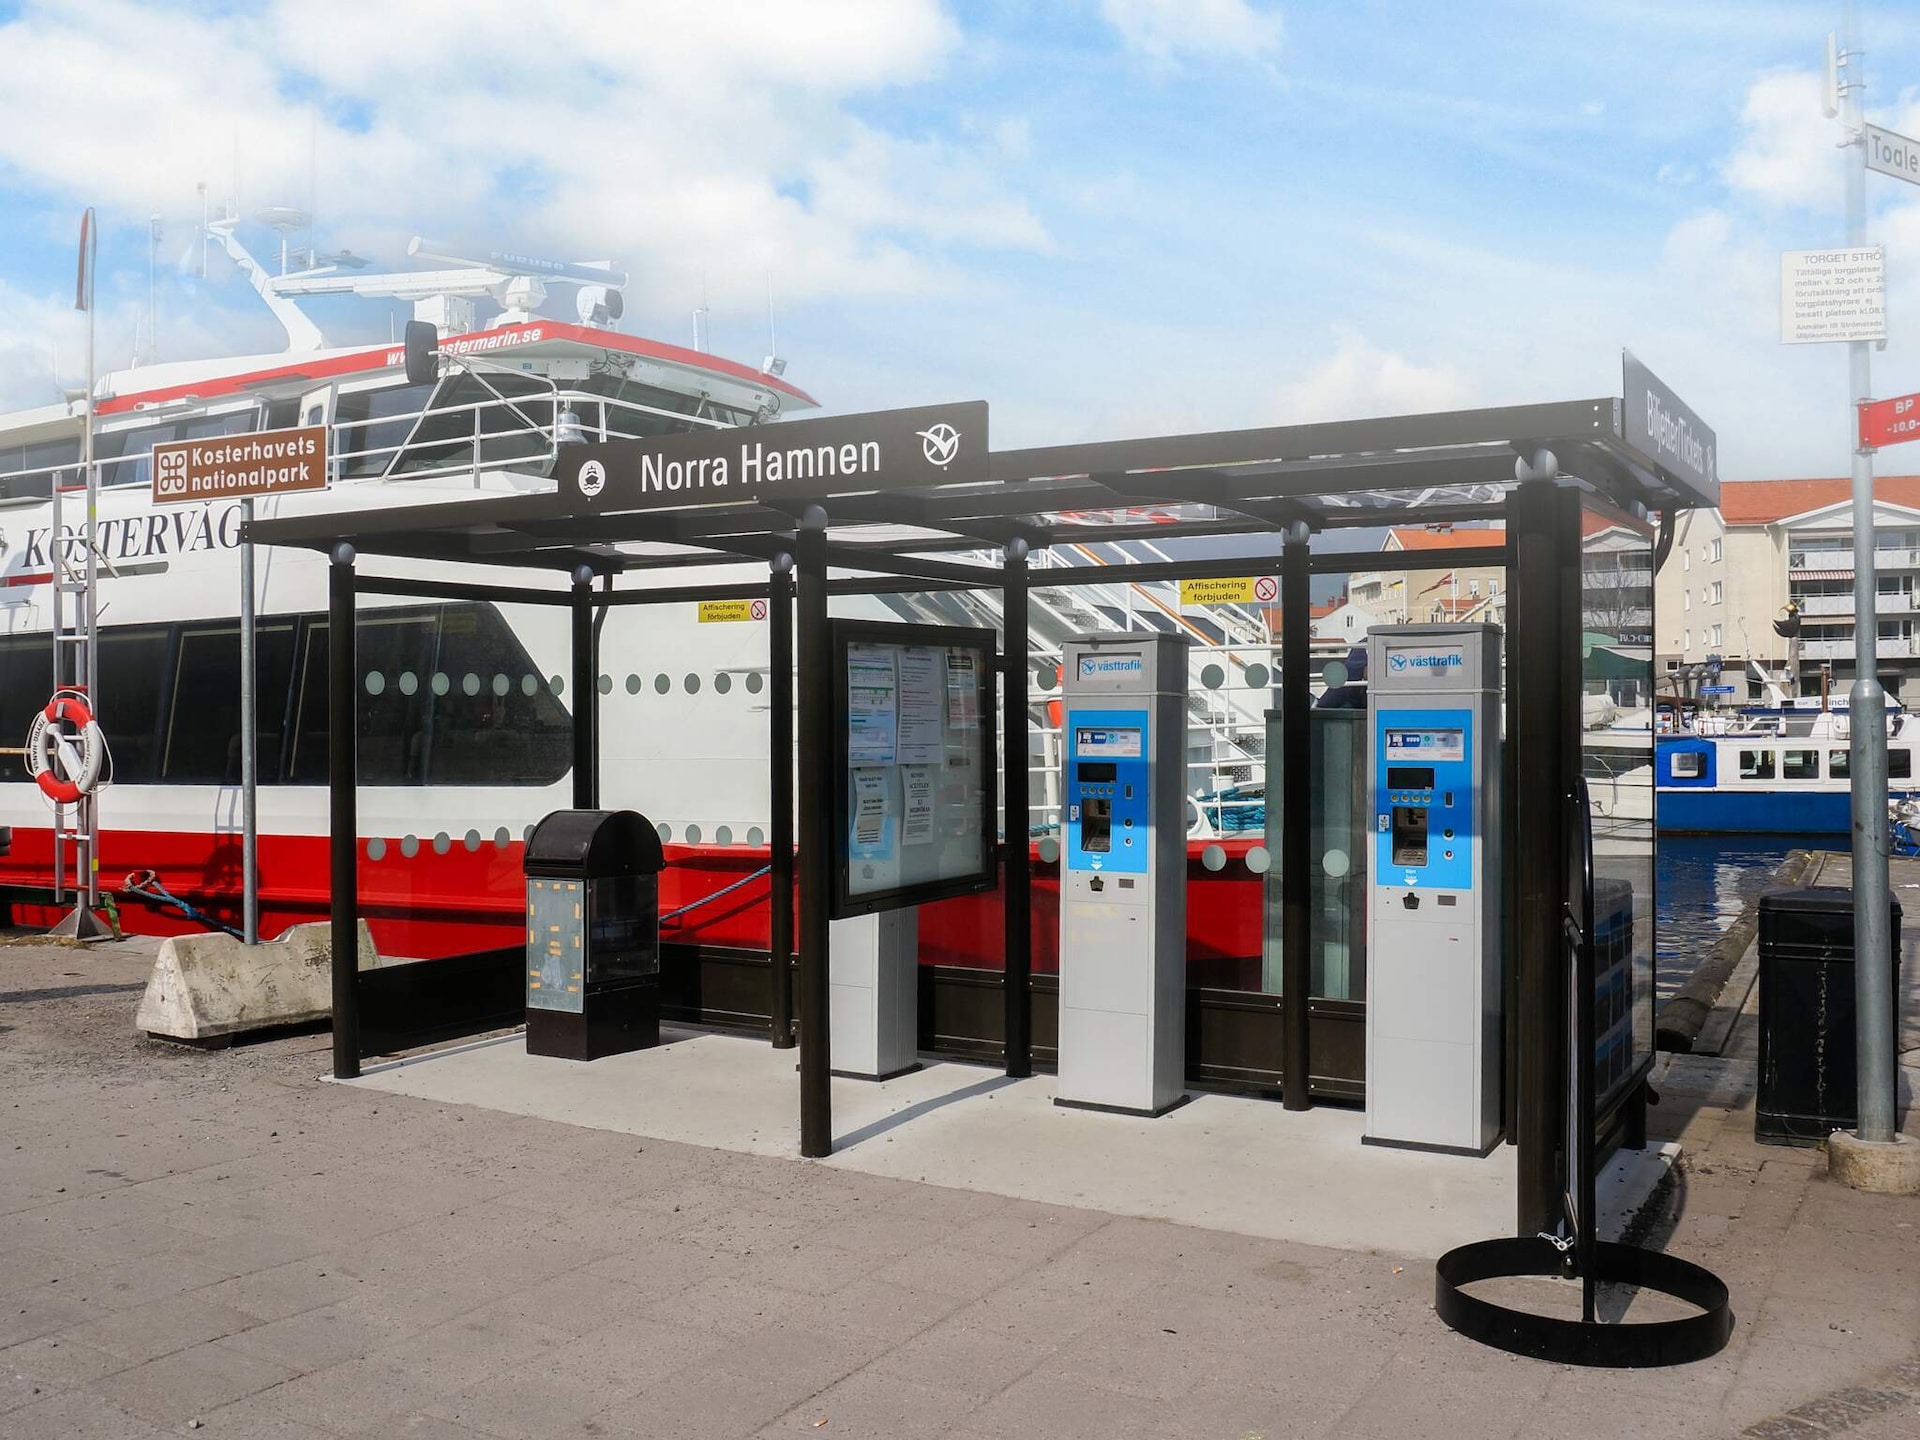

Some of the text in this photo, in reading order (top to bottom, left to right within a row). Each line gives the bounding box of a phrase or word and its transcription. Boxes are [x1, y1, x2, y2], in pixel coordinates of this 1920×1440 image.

[1804, 253, 1848, 264] TORGET
[1895, 399, 1914, 415] BP
[192, 436, 316, 467] Kosterhavets
[641, 439, 880, 494] Norra Hamnen
[192, 462, 310, 492] nationalpark
[22, 501, 243, 568] KOSTERVÅG
[1187, 581, 1246, 591] Affischering
[703, 603, 745, 611] Affischering
[1409, 654, 1462, 667] västtrafik
